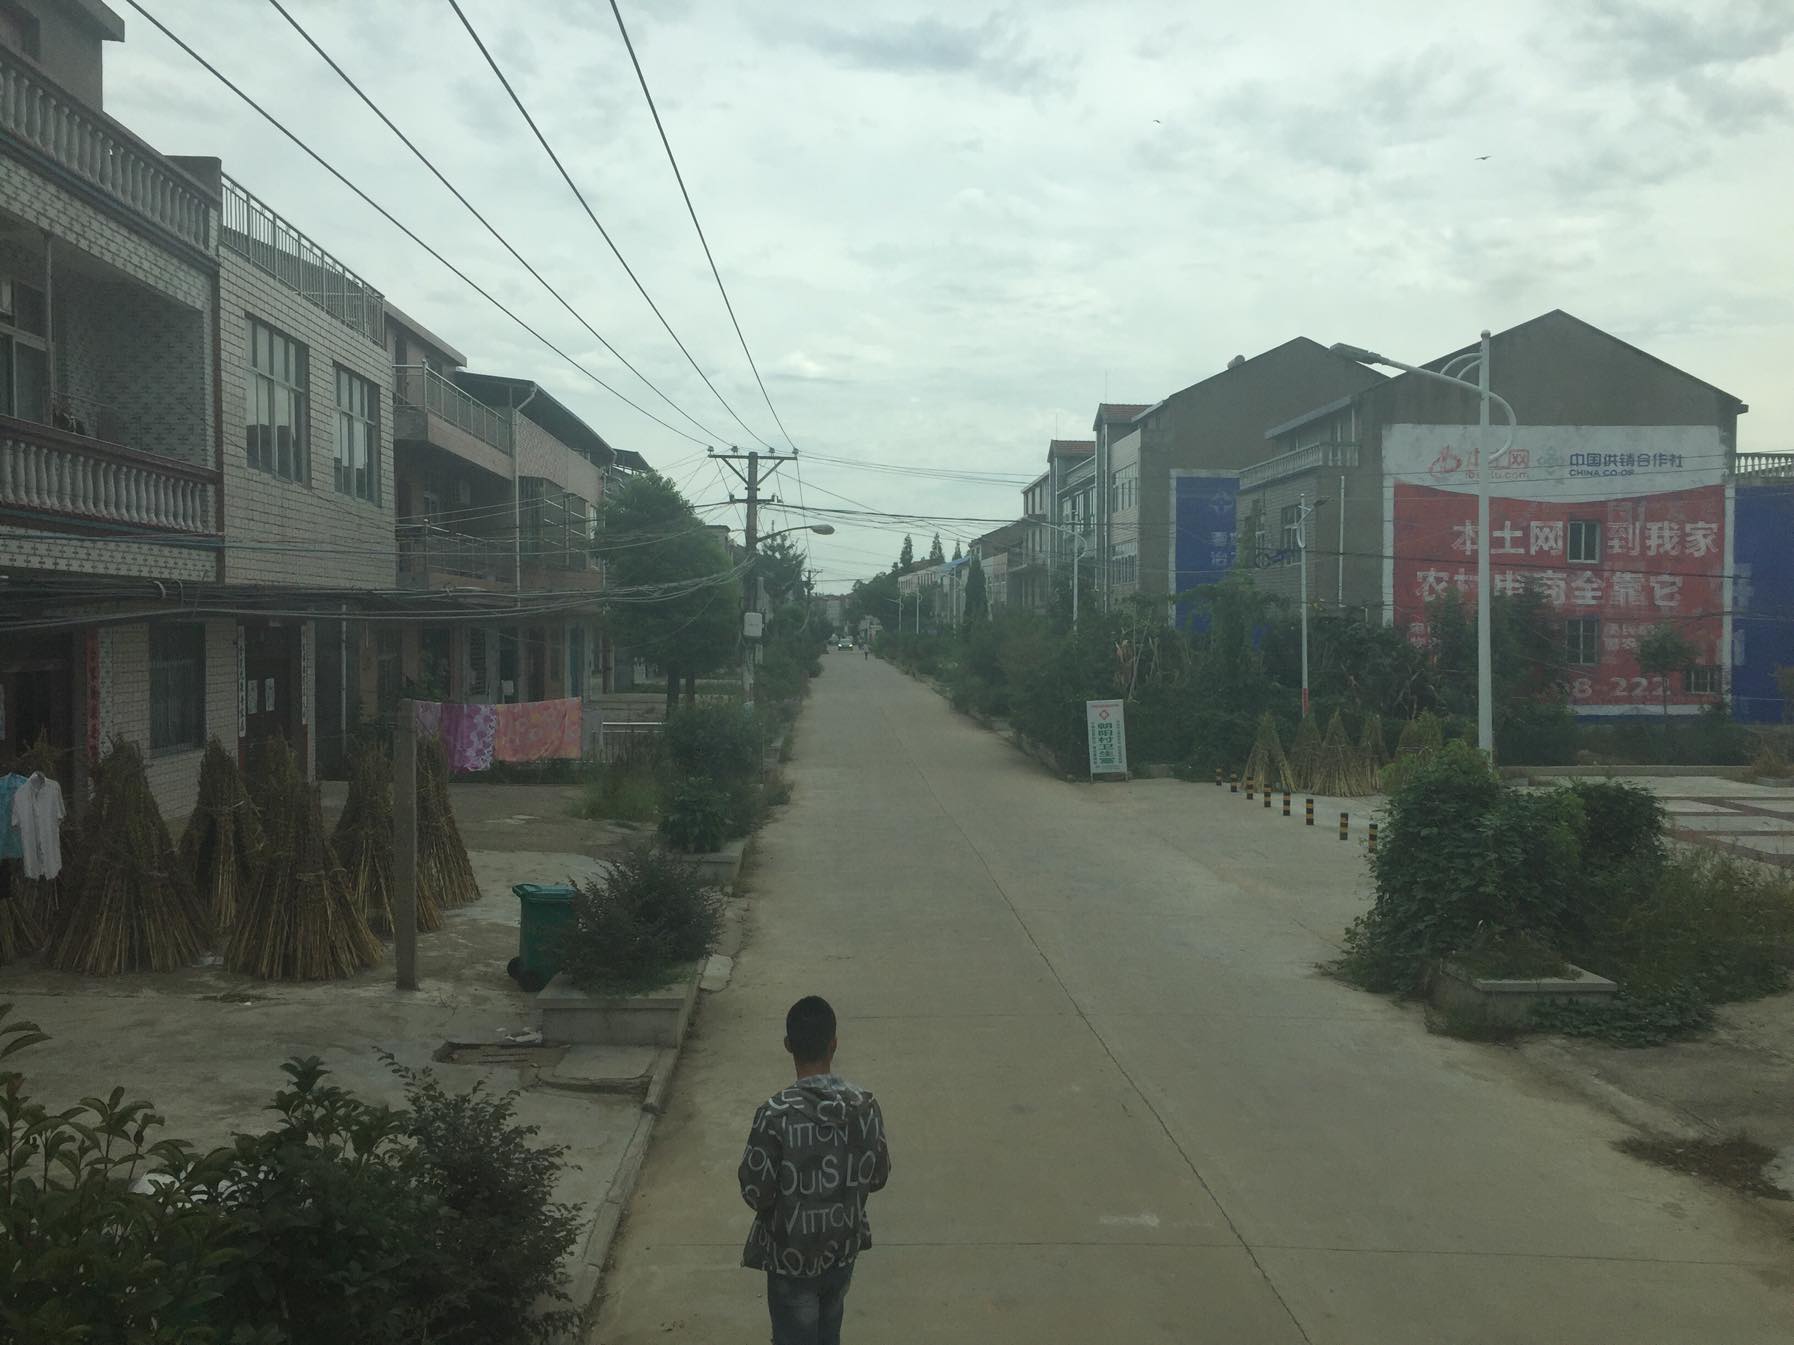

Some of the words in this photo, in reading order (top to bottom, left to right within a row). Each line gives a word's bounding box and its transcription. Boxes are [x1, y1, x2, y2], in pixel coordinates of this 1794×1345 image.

[1570, 452, 1683, 468] 中国供销合作社
